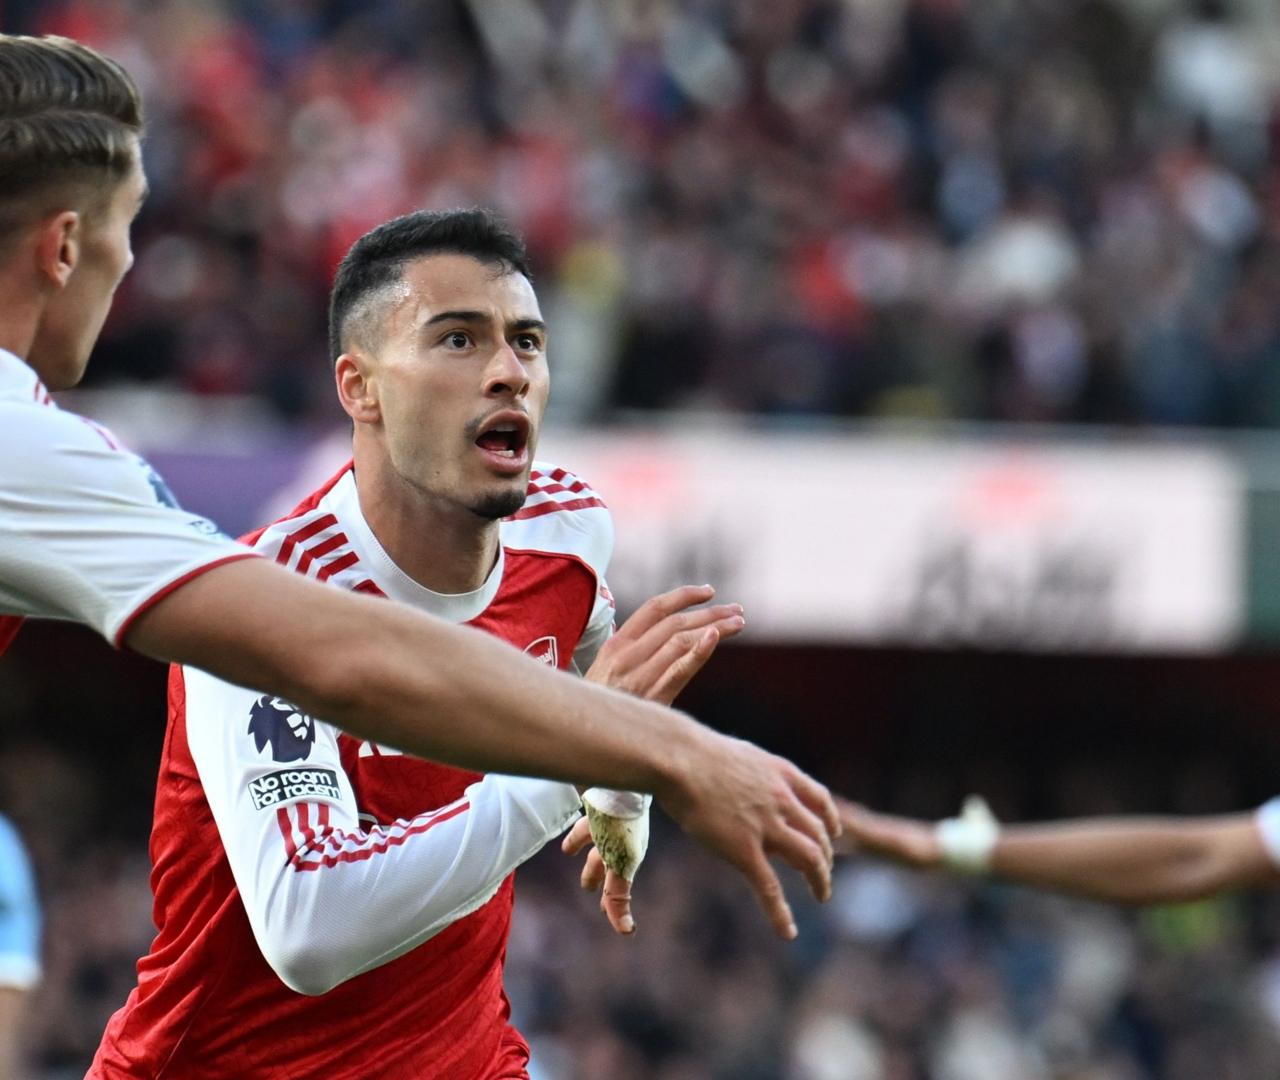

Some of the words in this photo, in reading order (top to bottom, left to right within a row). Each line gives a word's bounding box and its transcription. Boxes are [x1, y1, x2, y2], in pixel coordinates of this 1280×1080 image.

[248, 776, 279, 798] No
[280, 771, 332, 786] room
[253, 788, 281, 810] for
[284, 783, 341, 800] racism
